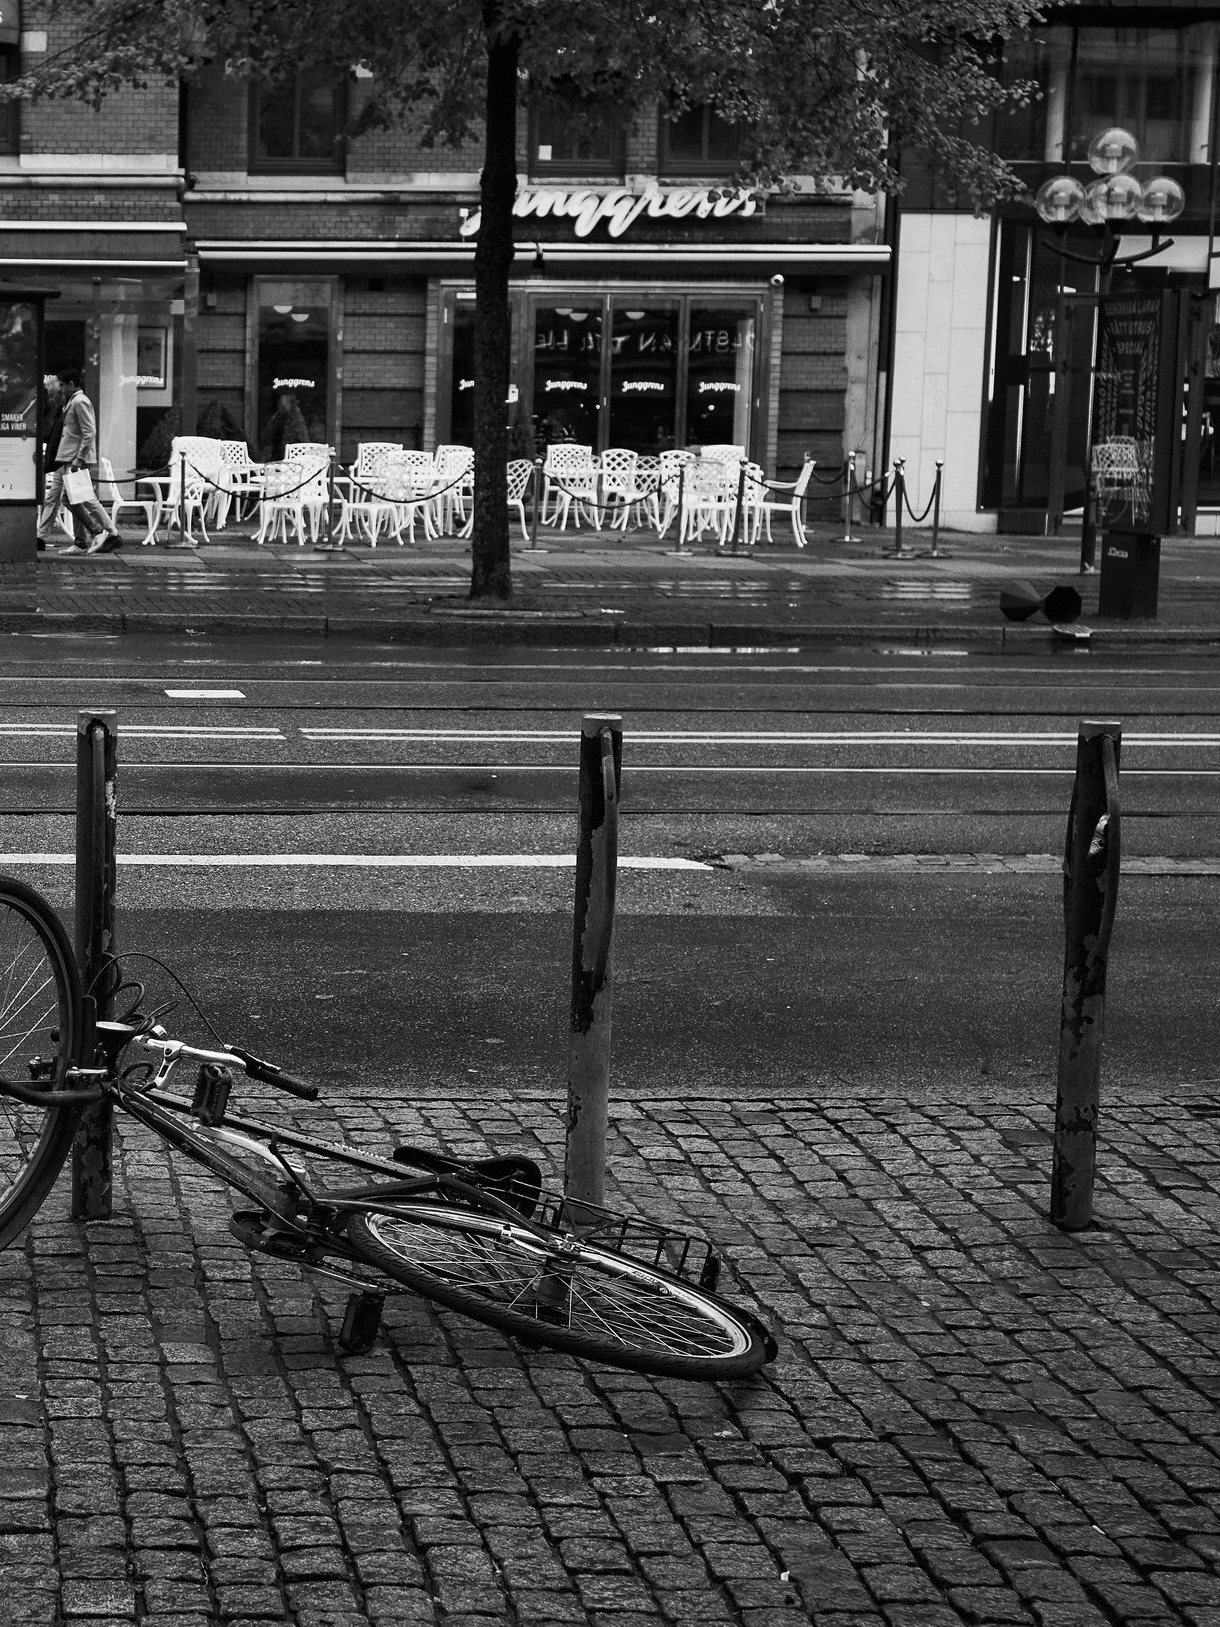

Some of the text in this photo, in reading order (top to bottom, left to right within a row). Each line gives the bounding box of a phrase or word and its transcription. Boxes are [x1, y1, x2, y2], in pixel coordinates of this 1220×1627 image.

[272, 377, 316, 389] Junggrens
[545, 380, 588, 392] Junggrens
[622, 381, 664, 392] Junggrens
[698, 381, 741, 393] Junggrens
[11, 422, 27, 430] VINER
